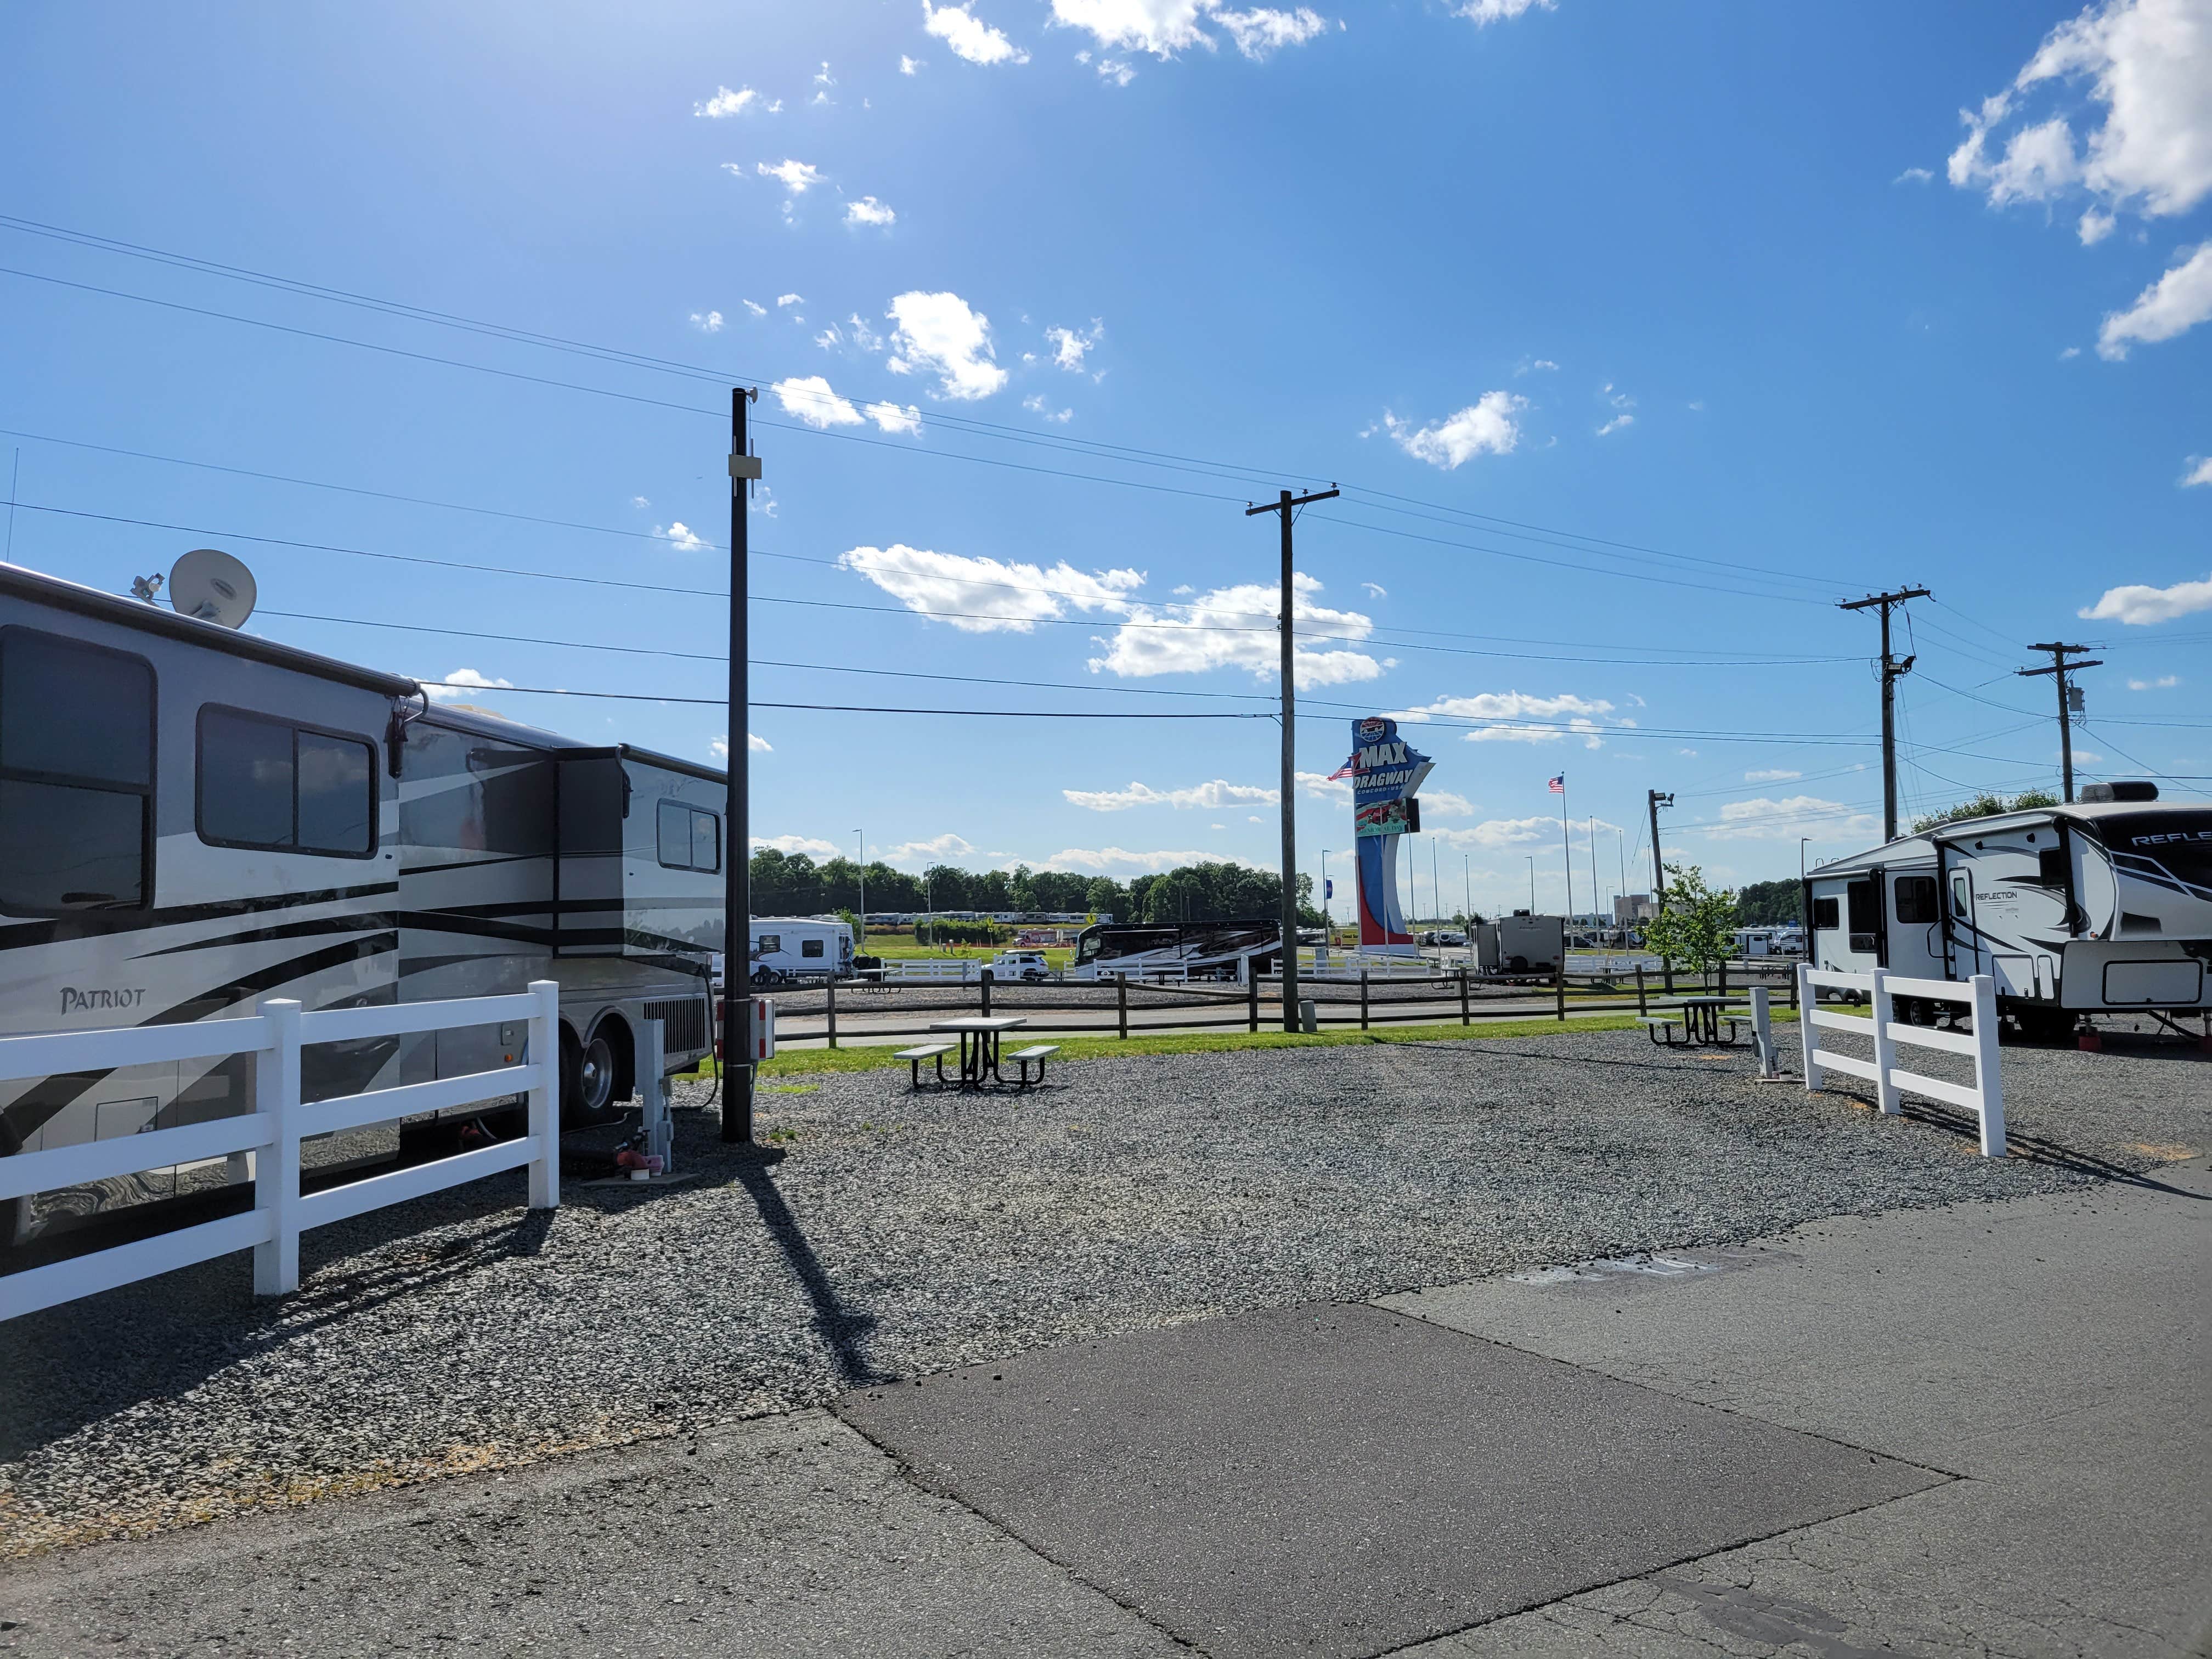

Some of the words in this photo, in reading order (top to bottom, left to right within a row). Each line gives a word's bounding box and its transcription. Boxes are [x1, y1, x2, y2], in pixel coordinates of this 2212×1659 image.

[1352, 769, 1413, 789] DRAGWAY
[1357, 787, 1386, 795] CONCORD
[2131, 831, 2212, 846] REFLE
[1976, 891, 2018, 901] REFLECTION
[59, 987, 146, 1015] PATRIOT
